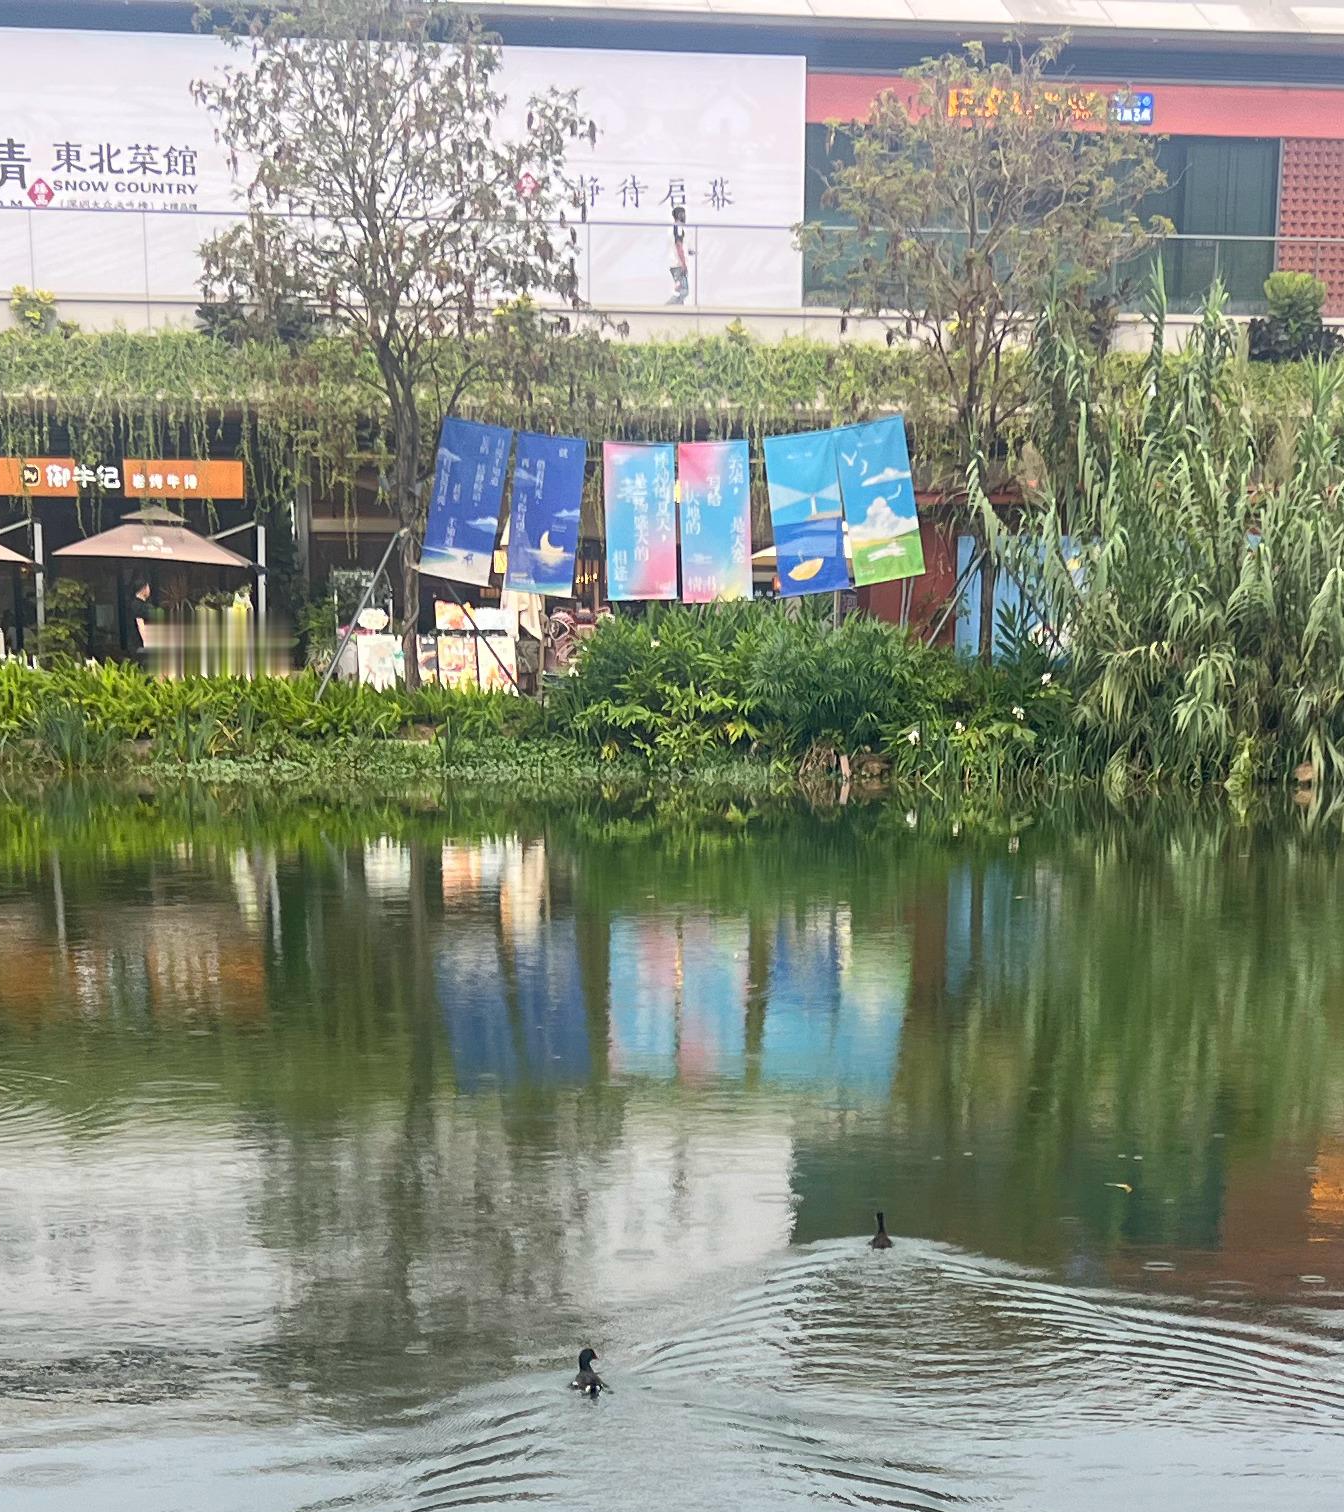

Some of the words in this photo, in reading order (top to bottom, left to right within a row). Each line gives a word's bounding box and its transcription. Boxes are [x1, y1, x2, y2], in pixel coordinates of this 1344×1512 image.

[52, 140, 198, 177] 東北菜館
[53, 179, 108, 192] SNOW
[114, 182, 198, 196] COUNTRY
[45, 464, 121, 489] 御牛记
